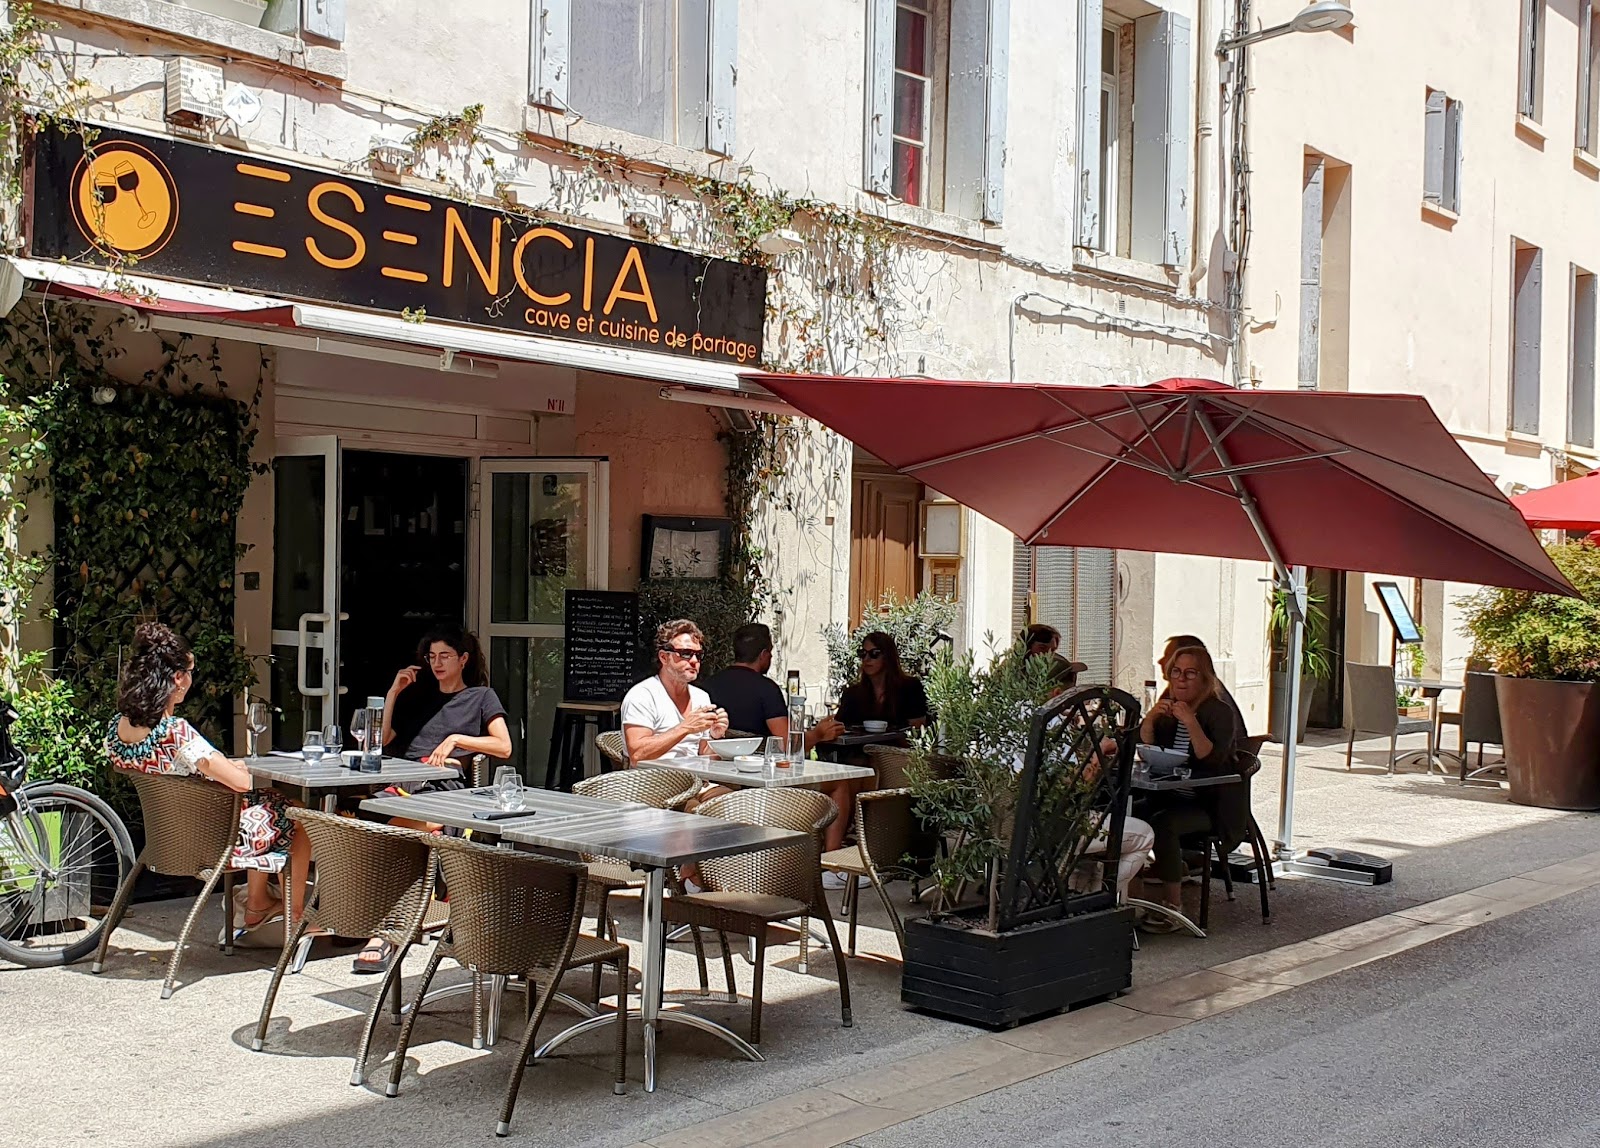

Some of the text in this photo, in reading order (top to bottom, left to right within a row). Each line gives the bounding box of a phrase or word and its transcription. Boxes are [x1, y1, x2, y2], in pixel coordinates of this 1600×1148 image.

[232, 163, 659, 323] ESENCIA
[525, 308, 757, 363] cave et cuisine de partage
